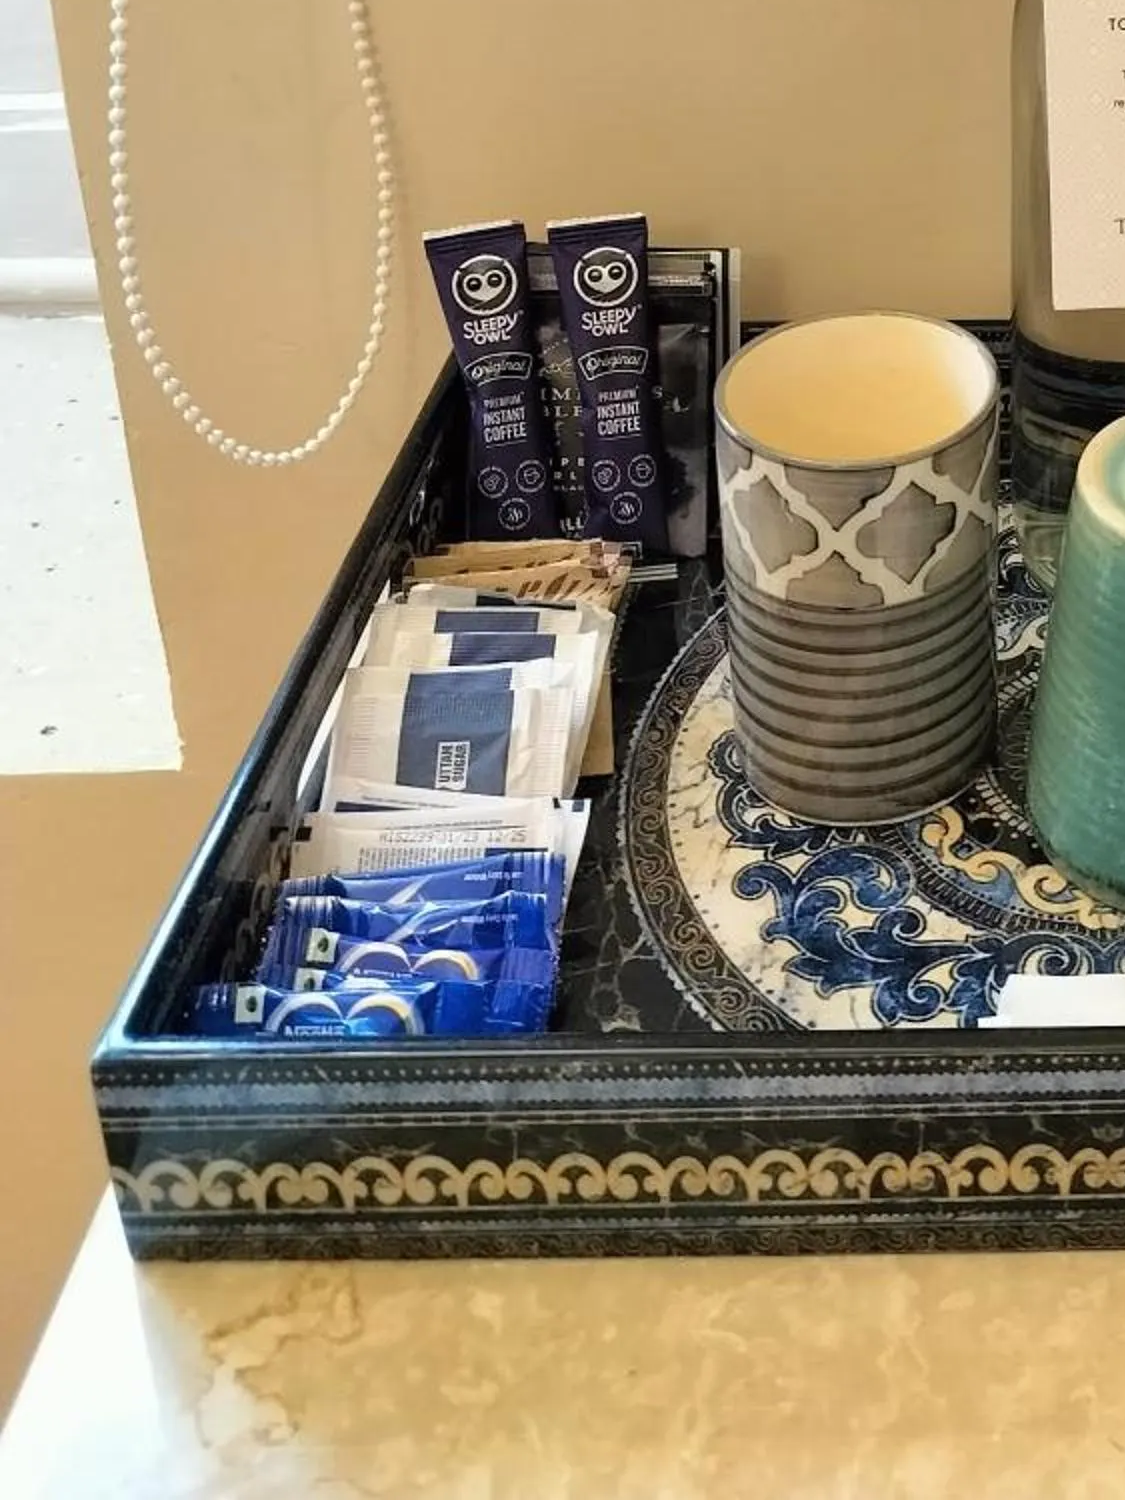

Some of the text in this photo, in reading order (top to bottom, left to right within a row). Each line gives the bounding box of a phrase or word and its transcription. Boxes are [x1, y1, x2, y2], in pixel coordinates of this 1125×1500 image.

[463, 312, 519, 339] SLEEPY
[581, 305, 637, 330] SLEEPY
[473, 330, 512, 345] OWL
[591, 322, 629, 337] OWL
[471, 358, 527, 379] Original
[585, 352, 642, 372] Original
[483, 406, 526, 426] INSTANT
[597, 401, 640, 419] INSTANT
[483, 421, 527, 443] COFFEE
[597, 416, 641, 436] COFFEE
[438, 745, 453, 783] UTTAM
[452, 744, 467, 783] SUGAR
